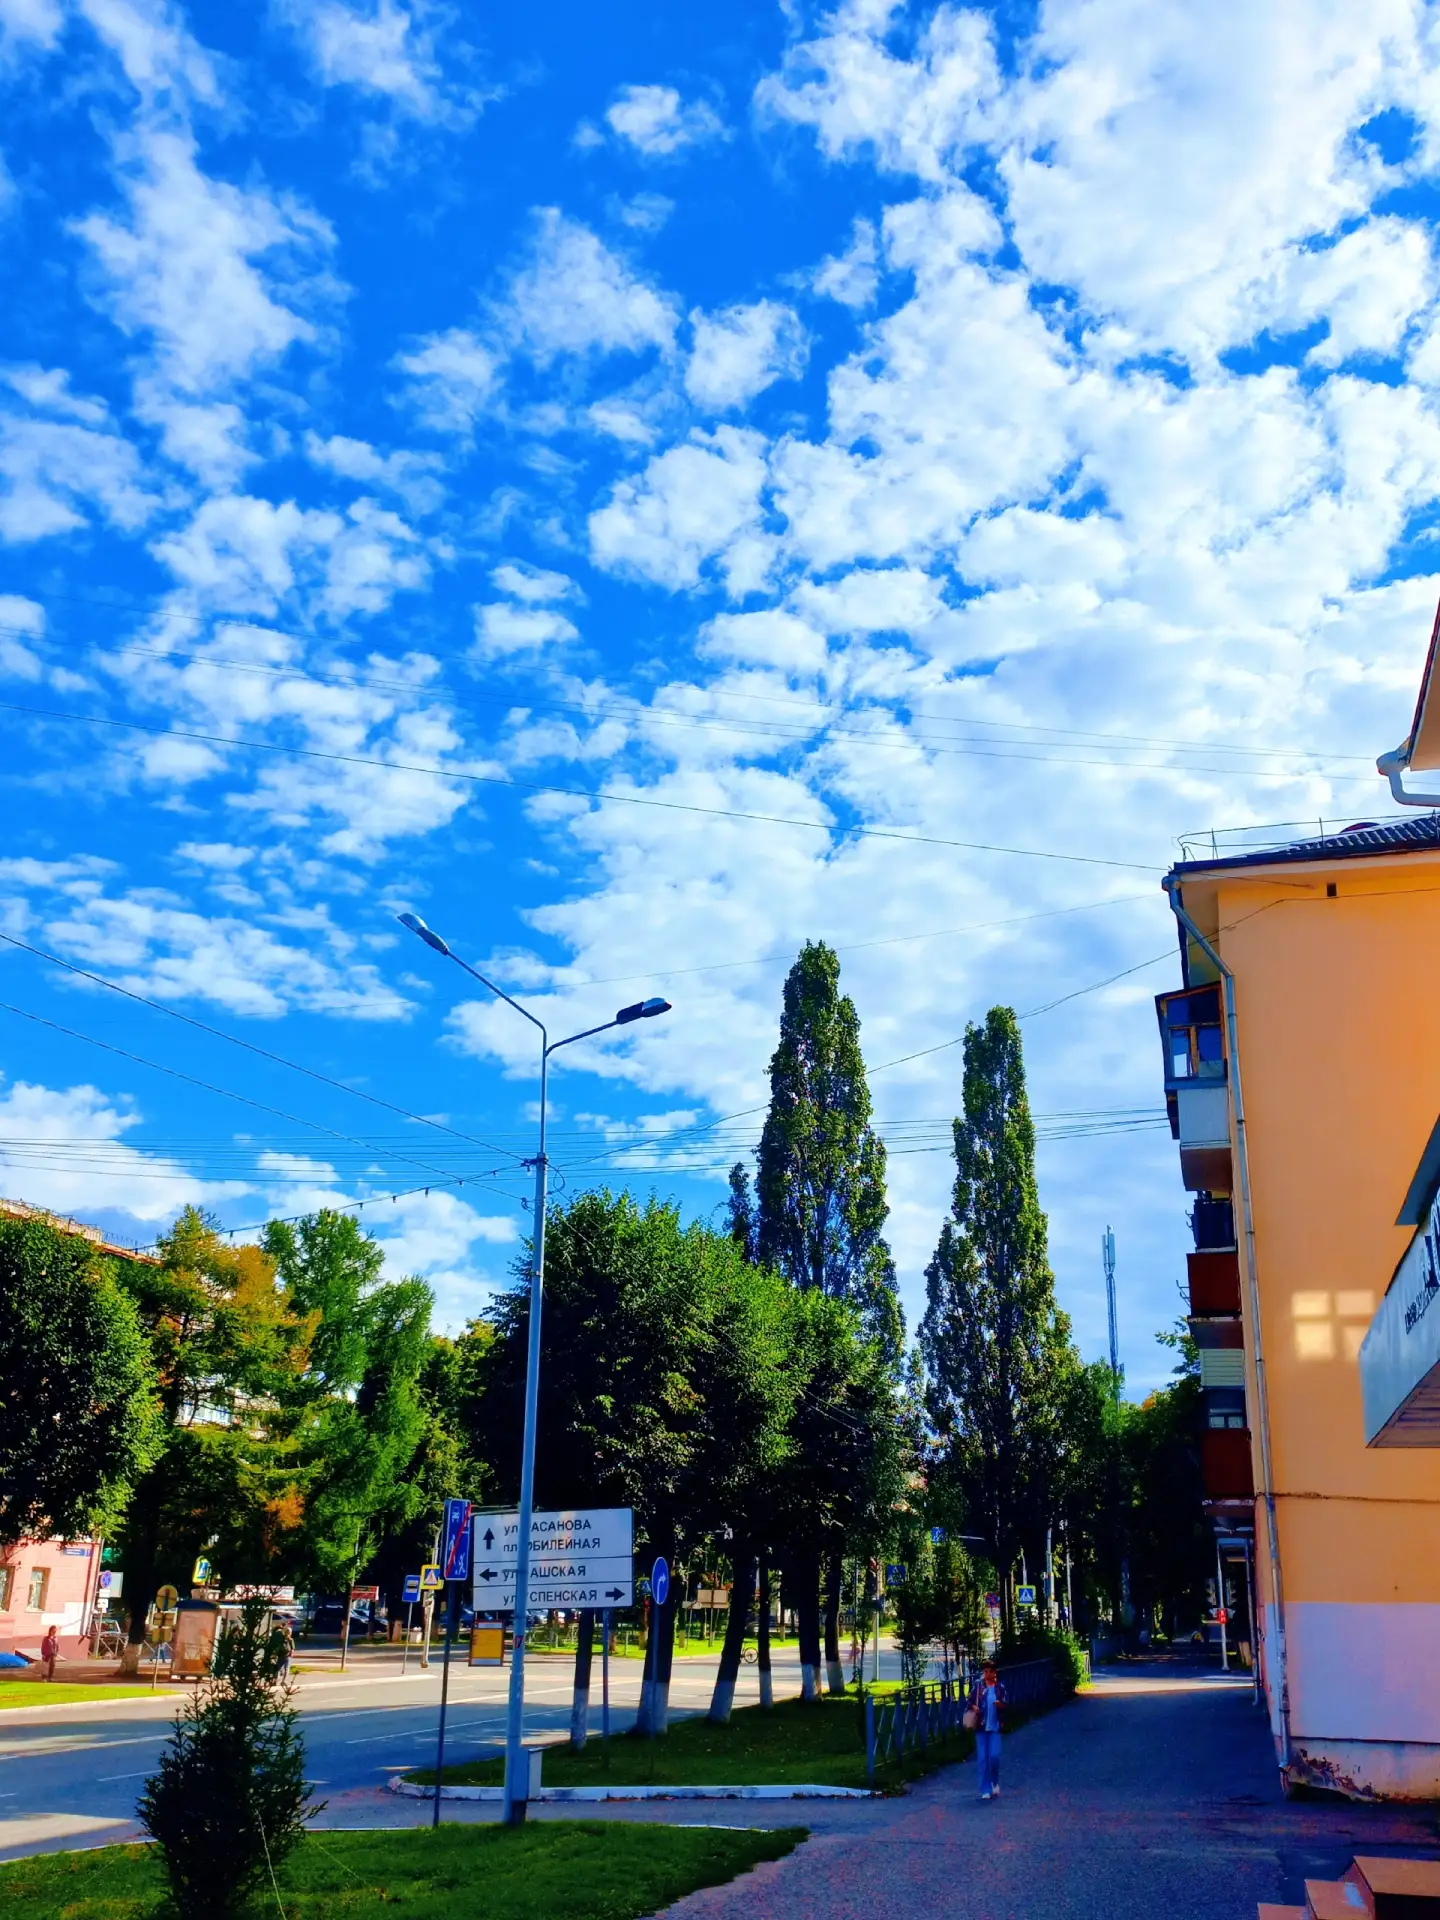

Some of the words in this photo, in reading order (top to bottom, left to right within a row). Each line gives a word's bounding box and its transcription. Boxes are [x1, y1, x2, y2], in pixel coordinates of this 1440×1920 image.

[531, 1519, 591, 1532] АСАНОВА
[530, 1565, 586, 1578] АШСКАЯ
[529, 1590, 597, 1602] СПЕНСКАЯ
